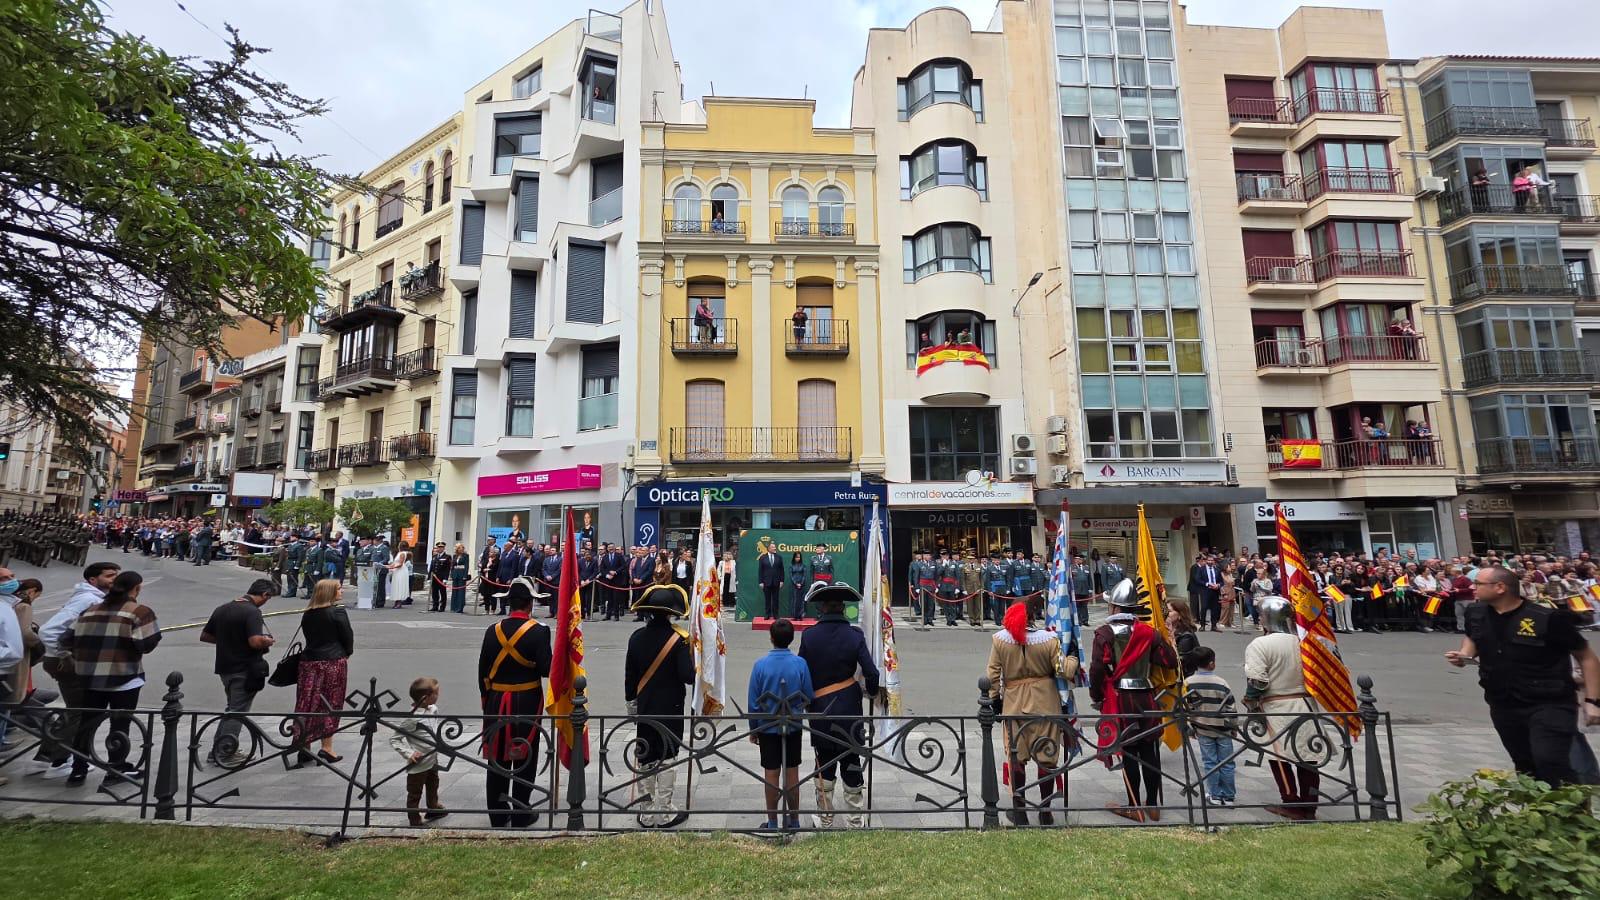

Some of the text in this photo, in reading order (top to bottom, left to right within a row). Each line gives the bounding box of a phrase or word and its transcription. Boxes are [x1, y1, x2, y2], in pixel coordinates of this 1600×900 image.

[1127, 466, 1181, 477] BARGAIN
[516, 474, 549, 485] SOLISS
[117, 490, 148, 500] Heras
[834, 491, 856, 500] Petra
[1258, 505, 1295, 517] Soia
[928, 513, 989, 524] PARFOIS
[1093, 519, 1121, 527] General
[777, 543, 817, 553] Guardia
